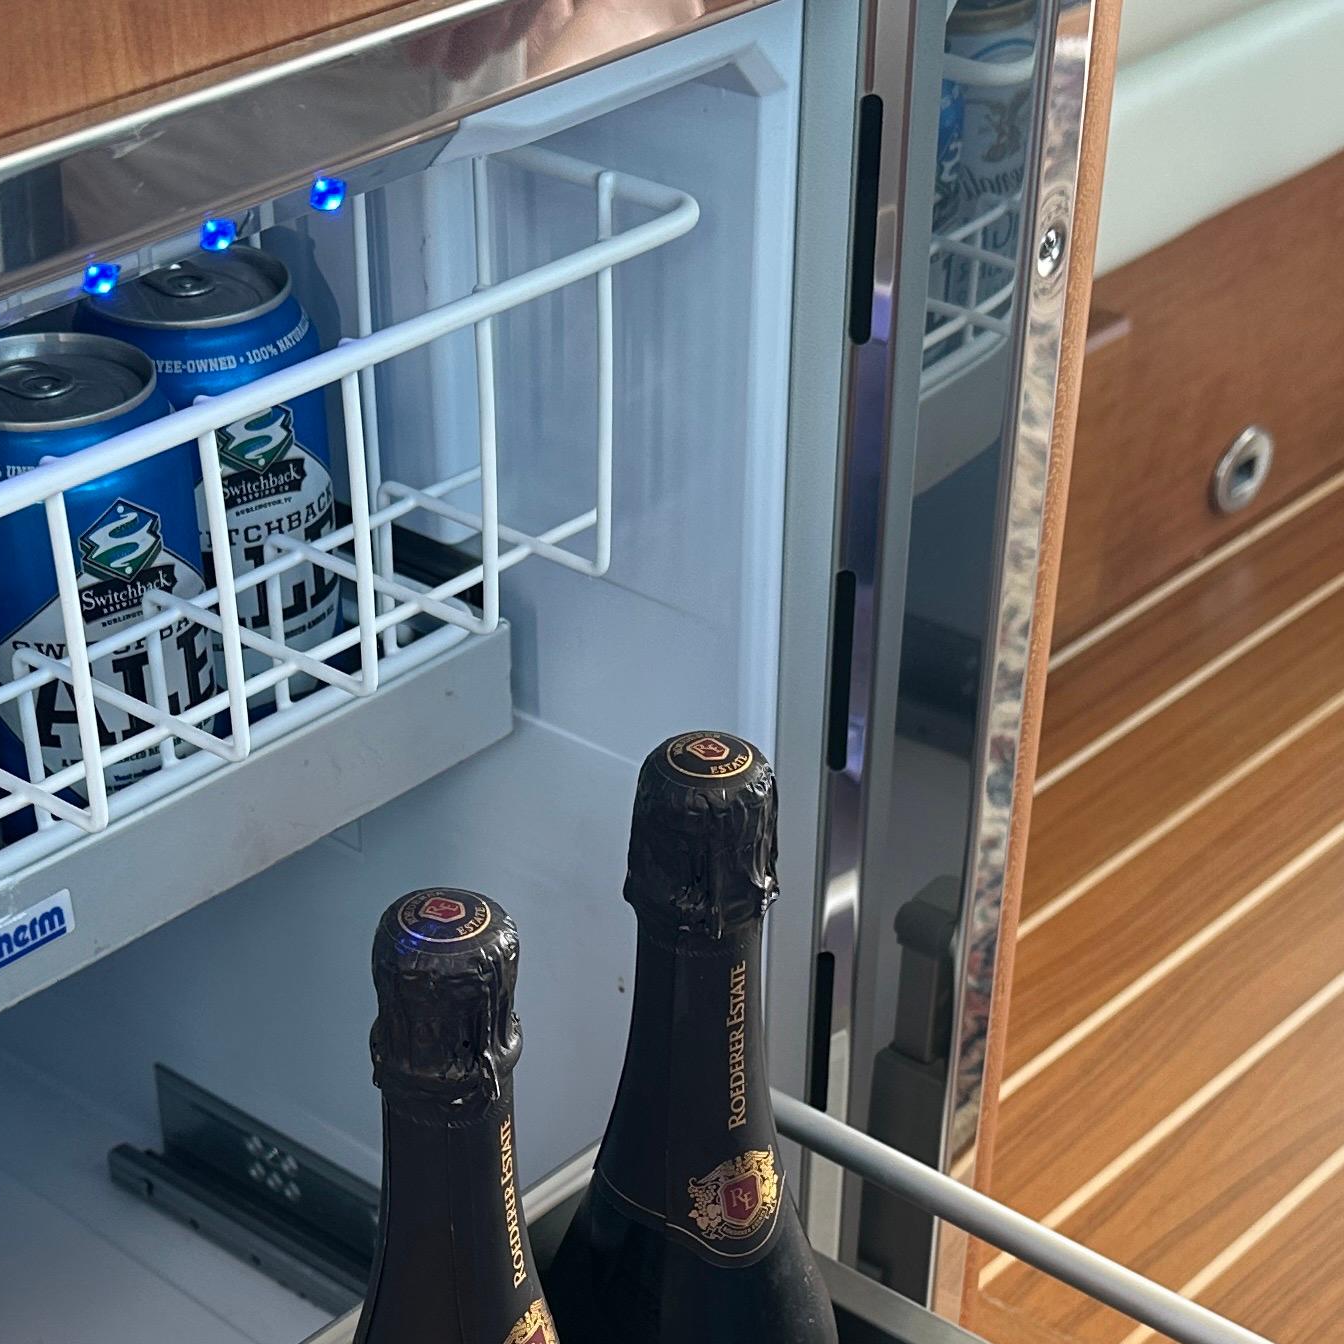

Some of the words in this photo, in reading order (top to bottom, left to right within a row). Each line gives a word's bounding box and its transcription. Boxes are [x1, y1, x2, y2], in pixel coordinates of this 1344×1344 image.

[246, 343, 279, 364] 100%
[81, 569, 172, 612] Switchback
[710, 754, 749, 775] ESTATE
[456, 905, 486, 937] ESTATE
[726, 959, 746, 1028] ESTATE
[728, 1027, 747, 1131] ROEDERER
[499, 1113, 514, 1187] ESTATE
[503, 1185, 528, 1288] ROEDERER
